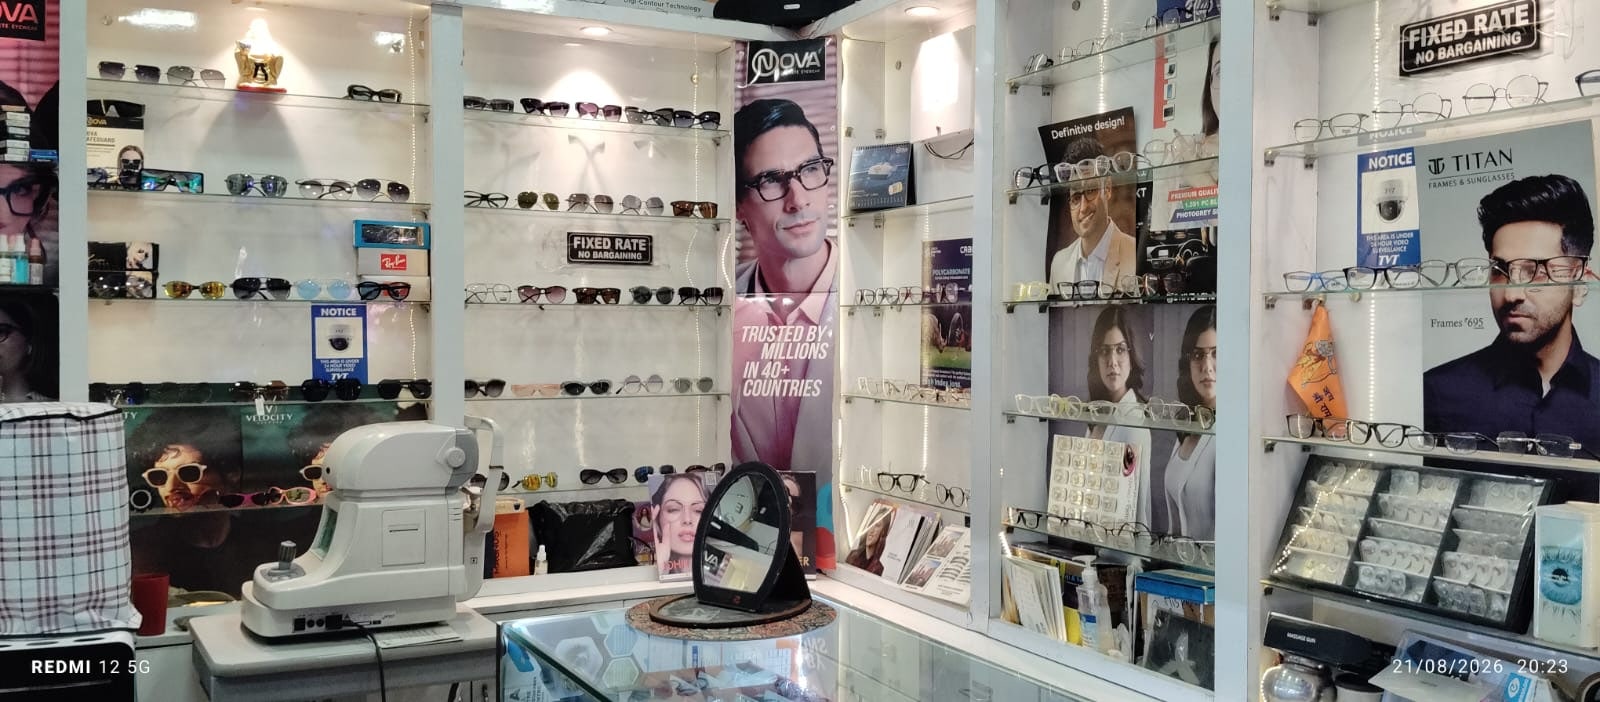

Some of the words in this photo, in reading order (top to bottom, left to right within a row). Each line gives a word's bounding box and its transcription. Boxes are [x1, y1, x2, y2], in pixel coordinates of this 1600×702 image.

[666, 2, 701, 12] Technology
[1409, 20, 1468, 49] FIXED
[1474, 3, 1529, 36] RATE
[1415, 50, 1434, 65] NO
[1437, 31, 1522, 60] BARGAINING
[1051, 124, 1093, 139] Definitive
[1094, 116, 1125, 130] design!
[1369, 152, 1413, 169] NOTICE
[1451, 147, 1513, 171] TITAN
[1428, 181, 1457, 189] FRAMES
[1466, 172, 1515, 185] SUNGLASSES
[1171, 191, 1197, 200] PREMIUM
[1176, 209, 1211, 219] PHOTOGREY
[573, 236, 612, 249] FIXED
[614, 238, 647, 251] RATE
[578, 250, 591, 259] NO
[593, 251, 642, 260] BARGAINING
[1378, 254, 1399, 266] TVT
[321, 308, 357, 316] NOTICE
[1431, 318, 1463, 328] Frames
[742, 325, 804, 342] TRUSTED
[806, 325, 828, 342] BY
[761, 342, 829, 360] MILLIONS
[743, 361, 760, 379] IN
[761, 361, 790, 379] 40+
[743, 379, 822, 397] COUNTRIES
[246, 413, 293, 421] VELOCITY
